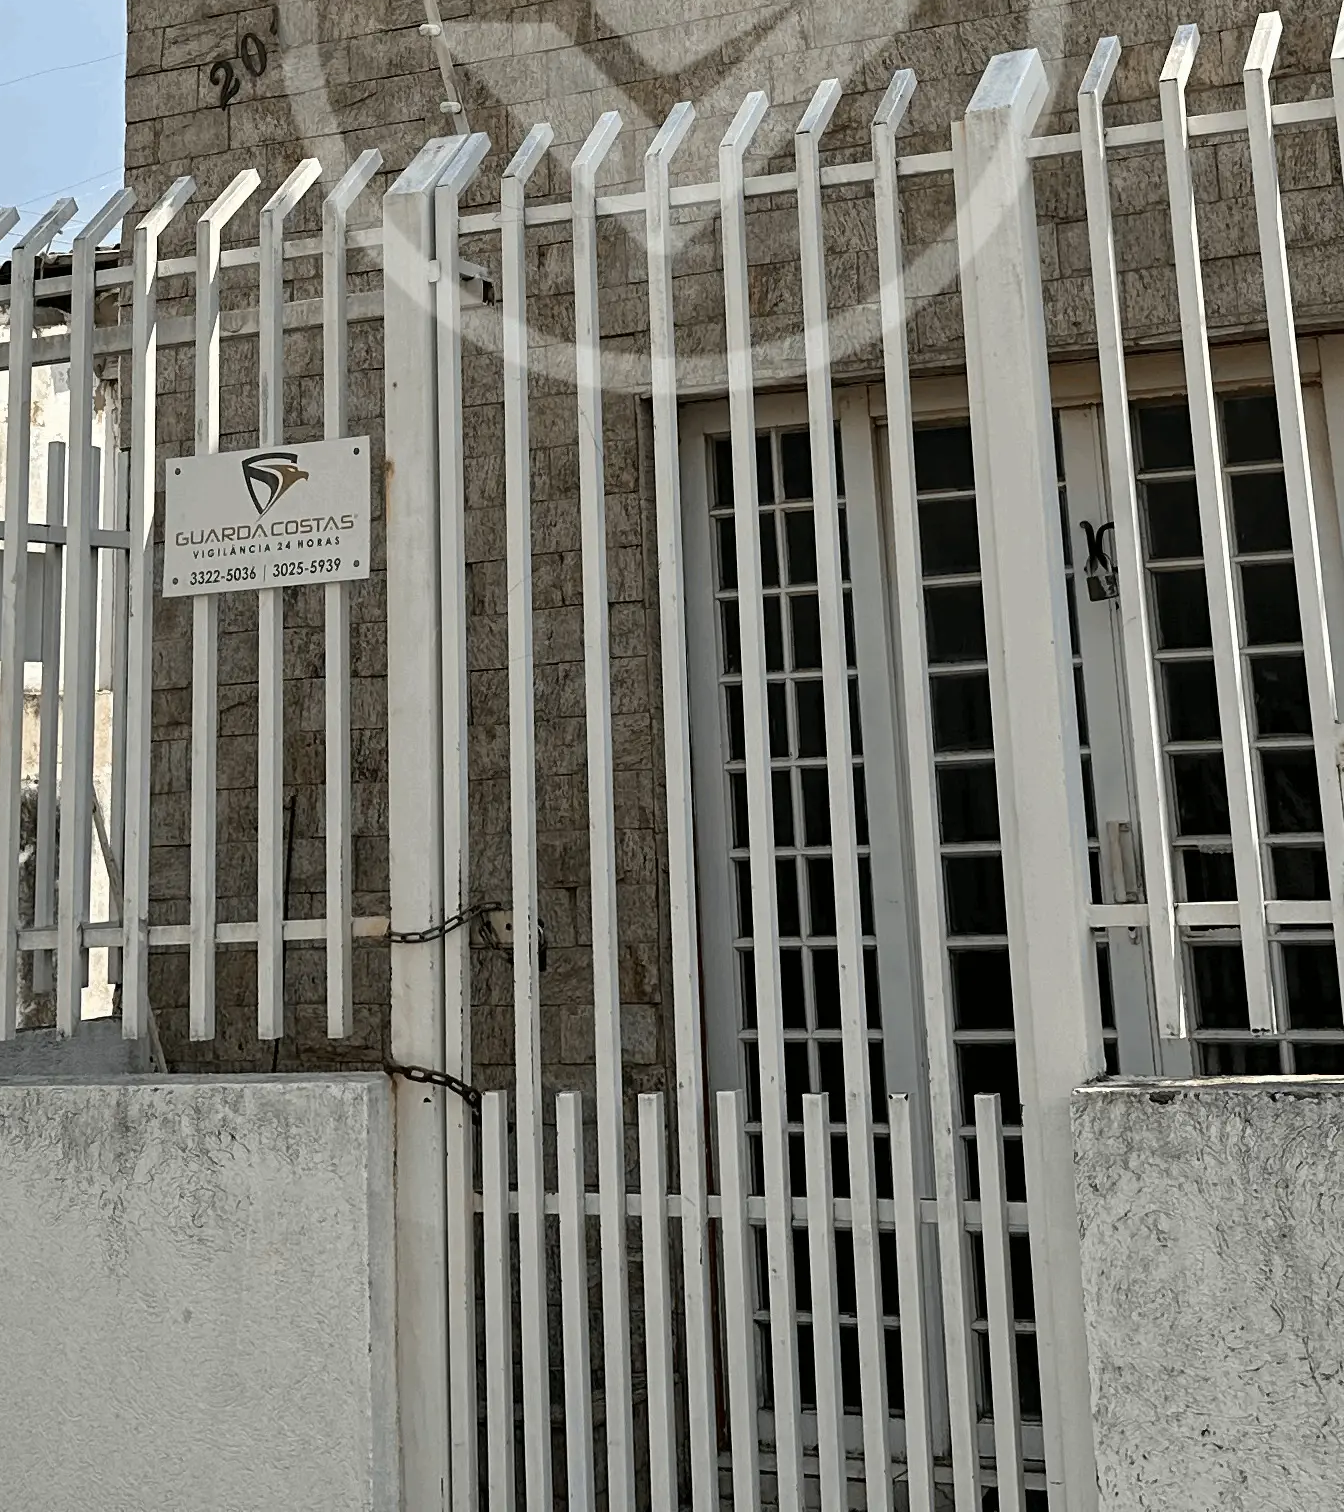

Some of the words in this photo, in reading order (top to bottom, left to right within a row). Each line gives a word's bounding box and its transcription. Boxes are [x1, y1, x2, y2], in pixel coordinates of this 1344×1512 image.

[192, 543, 271, 560] VIGILÂNCIA
[276, 541, 291, 551] 24
[297, 536, 341, 549] HORAS
[189, 566, 257, 586] 3322-5036
[272, 557, 342, 578] 3025-5939
